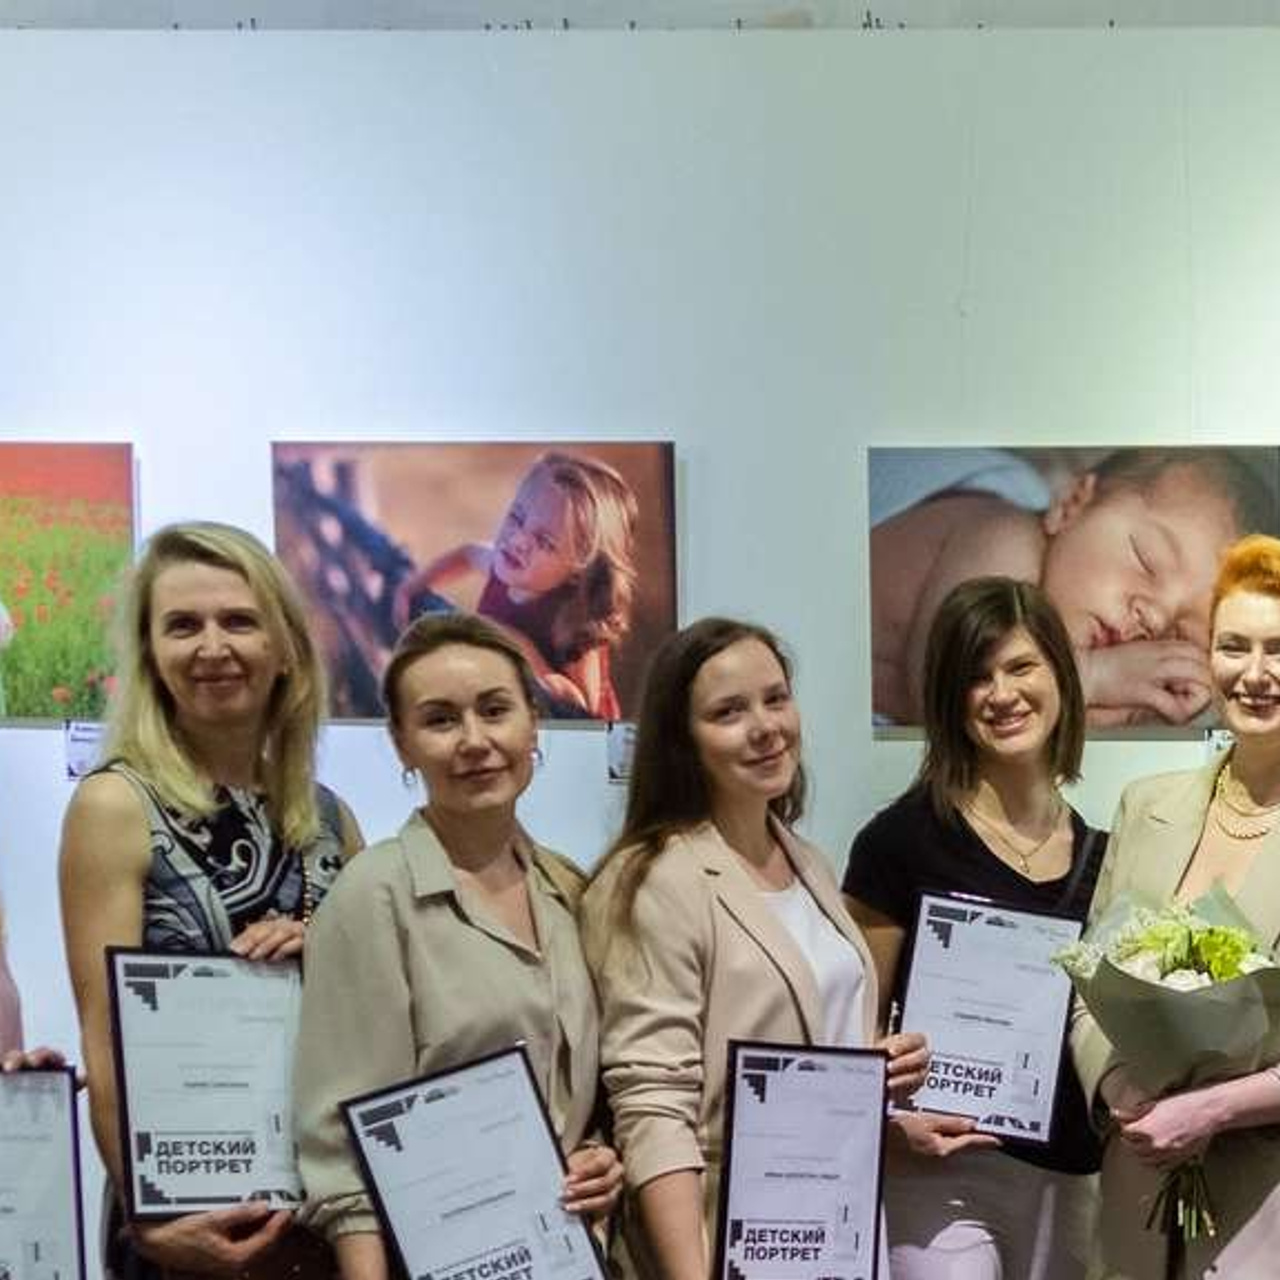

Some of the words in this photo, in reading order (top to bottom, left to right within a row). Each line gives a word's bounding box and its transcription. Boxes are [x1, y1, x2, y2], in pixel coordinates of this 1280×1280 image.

[930, 1061, 1003, 1084] ЕТСКИЙ
[926, 1076, 997, 1098] ОРТРЕТ
[156, 1137, 256, 1158] ДЕТСКИЙ
[157, 1159, 253, 1175] ПОРТРЕТ
[744, 1226, 826, 1244] ДЕТСКИЙ
[744, 1246, 822, 1261] ПОРТРЕТ
